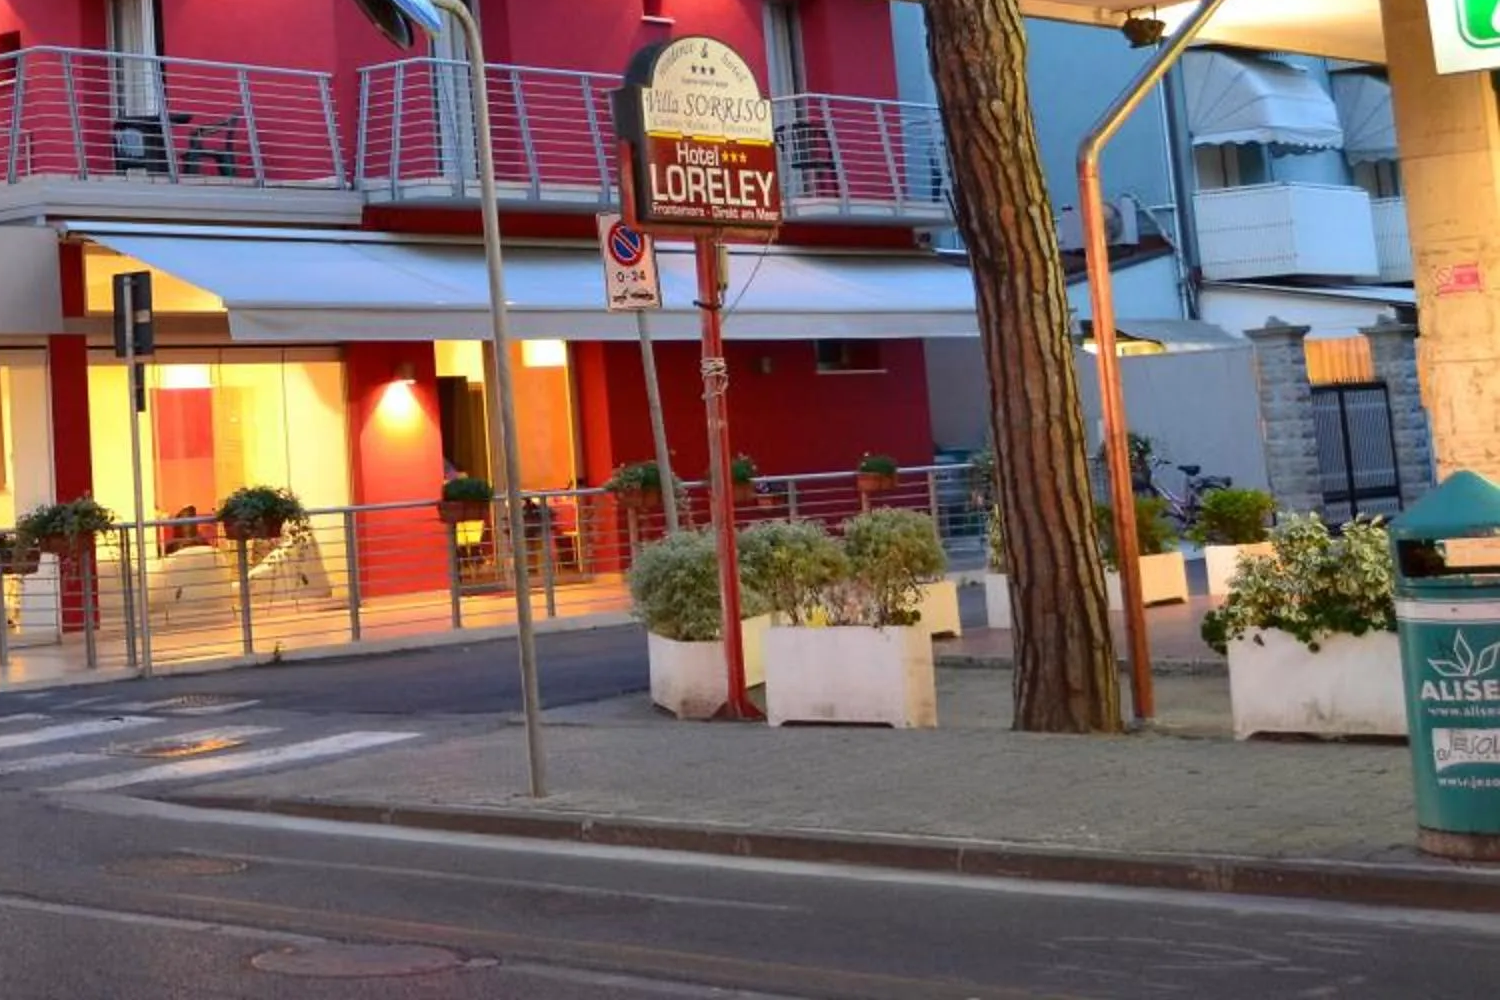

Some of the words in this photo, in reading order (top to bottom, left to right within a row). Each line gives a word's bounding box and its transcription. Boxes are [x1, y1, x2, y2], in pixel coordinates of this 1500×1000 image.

[645, 88, 680, 114] Villa
[682, 92, 768, 124] SORRISO
[675, 141, 720, 167] Hotel
[648, 162, 775, 208] LORELEY
